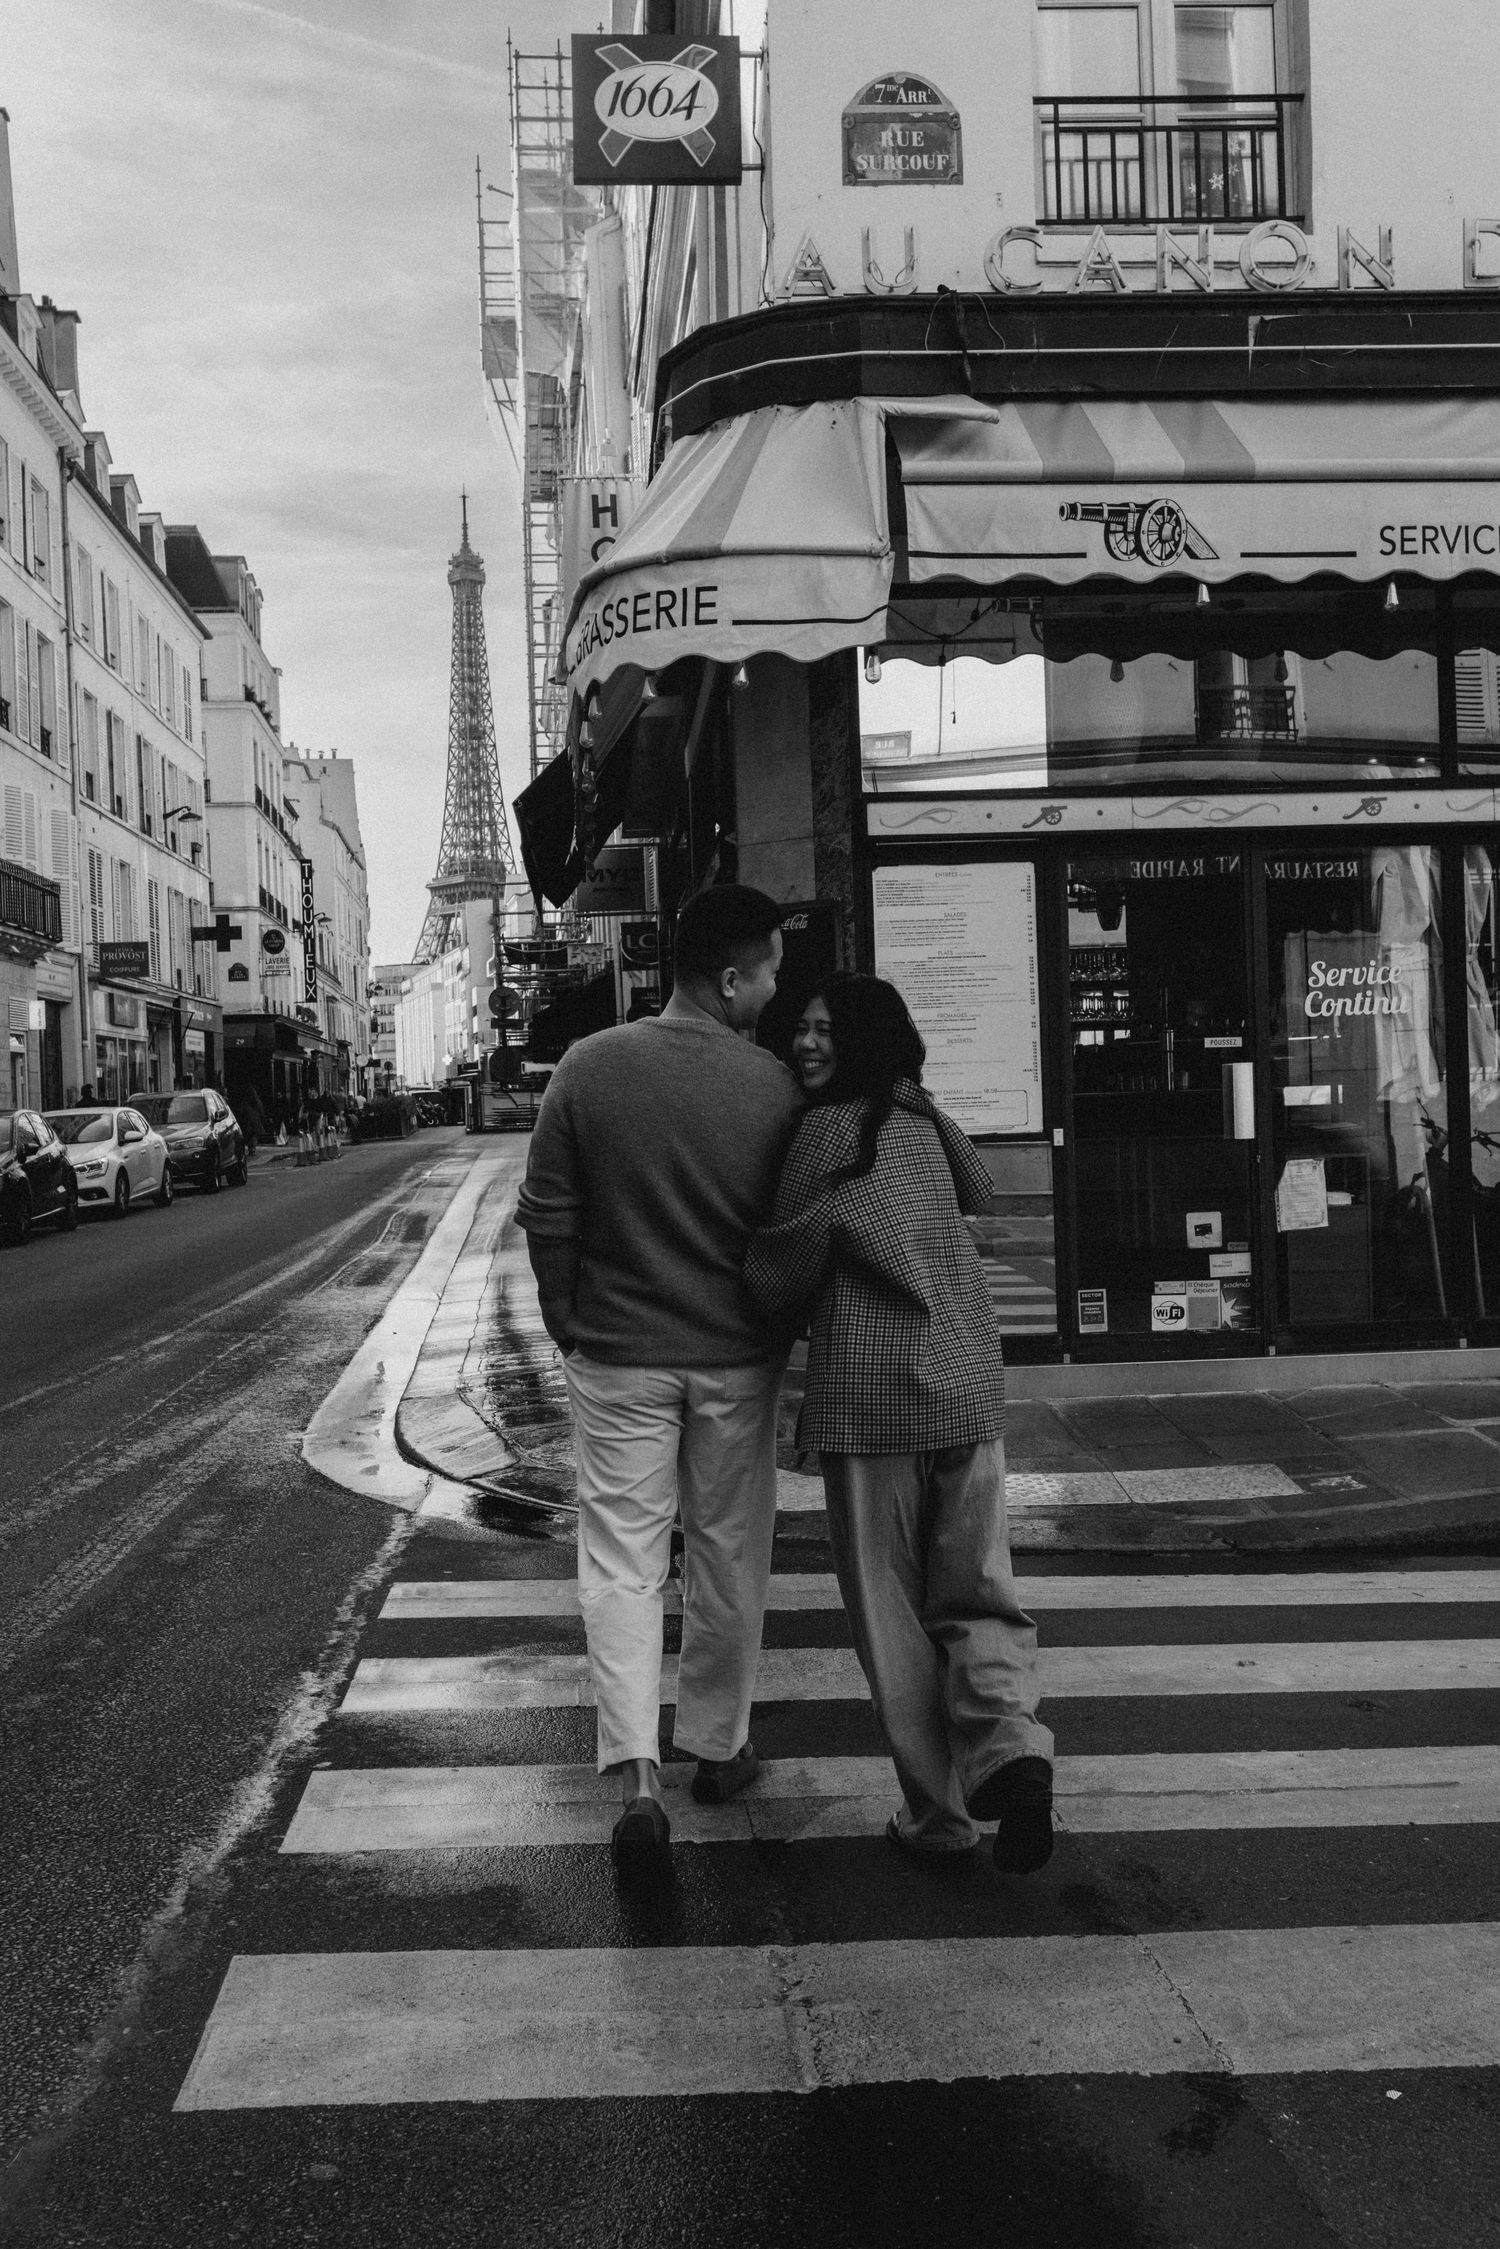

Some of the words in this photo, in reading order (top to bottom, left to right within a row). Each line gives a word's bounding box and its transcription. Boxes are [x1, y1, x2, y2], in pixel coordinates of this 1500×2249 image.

[607, 73, 707, 121] 1664
[880, 130, 924, 147] RUE
[856, 154, 949, 171] SURCOUF
[776, 225, 918, 297] AU
[983, 219, 1394, 294] CANON
[1379, 524, 1500, 556] SERVIC
[302, 863, 317, 999] THOUMIEUX
[102, 951, 145, 961] PROVOST
[1308, 960, 1401, 988] Service
[1305, 990, 1413, 1018] Continu
